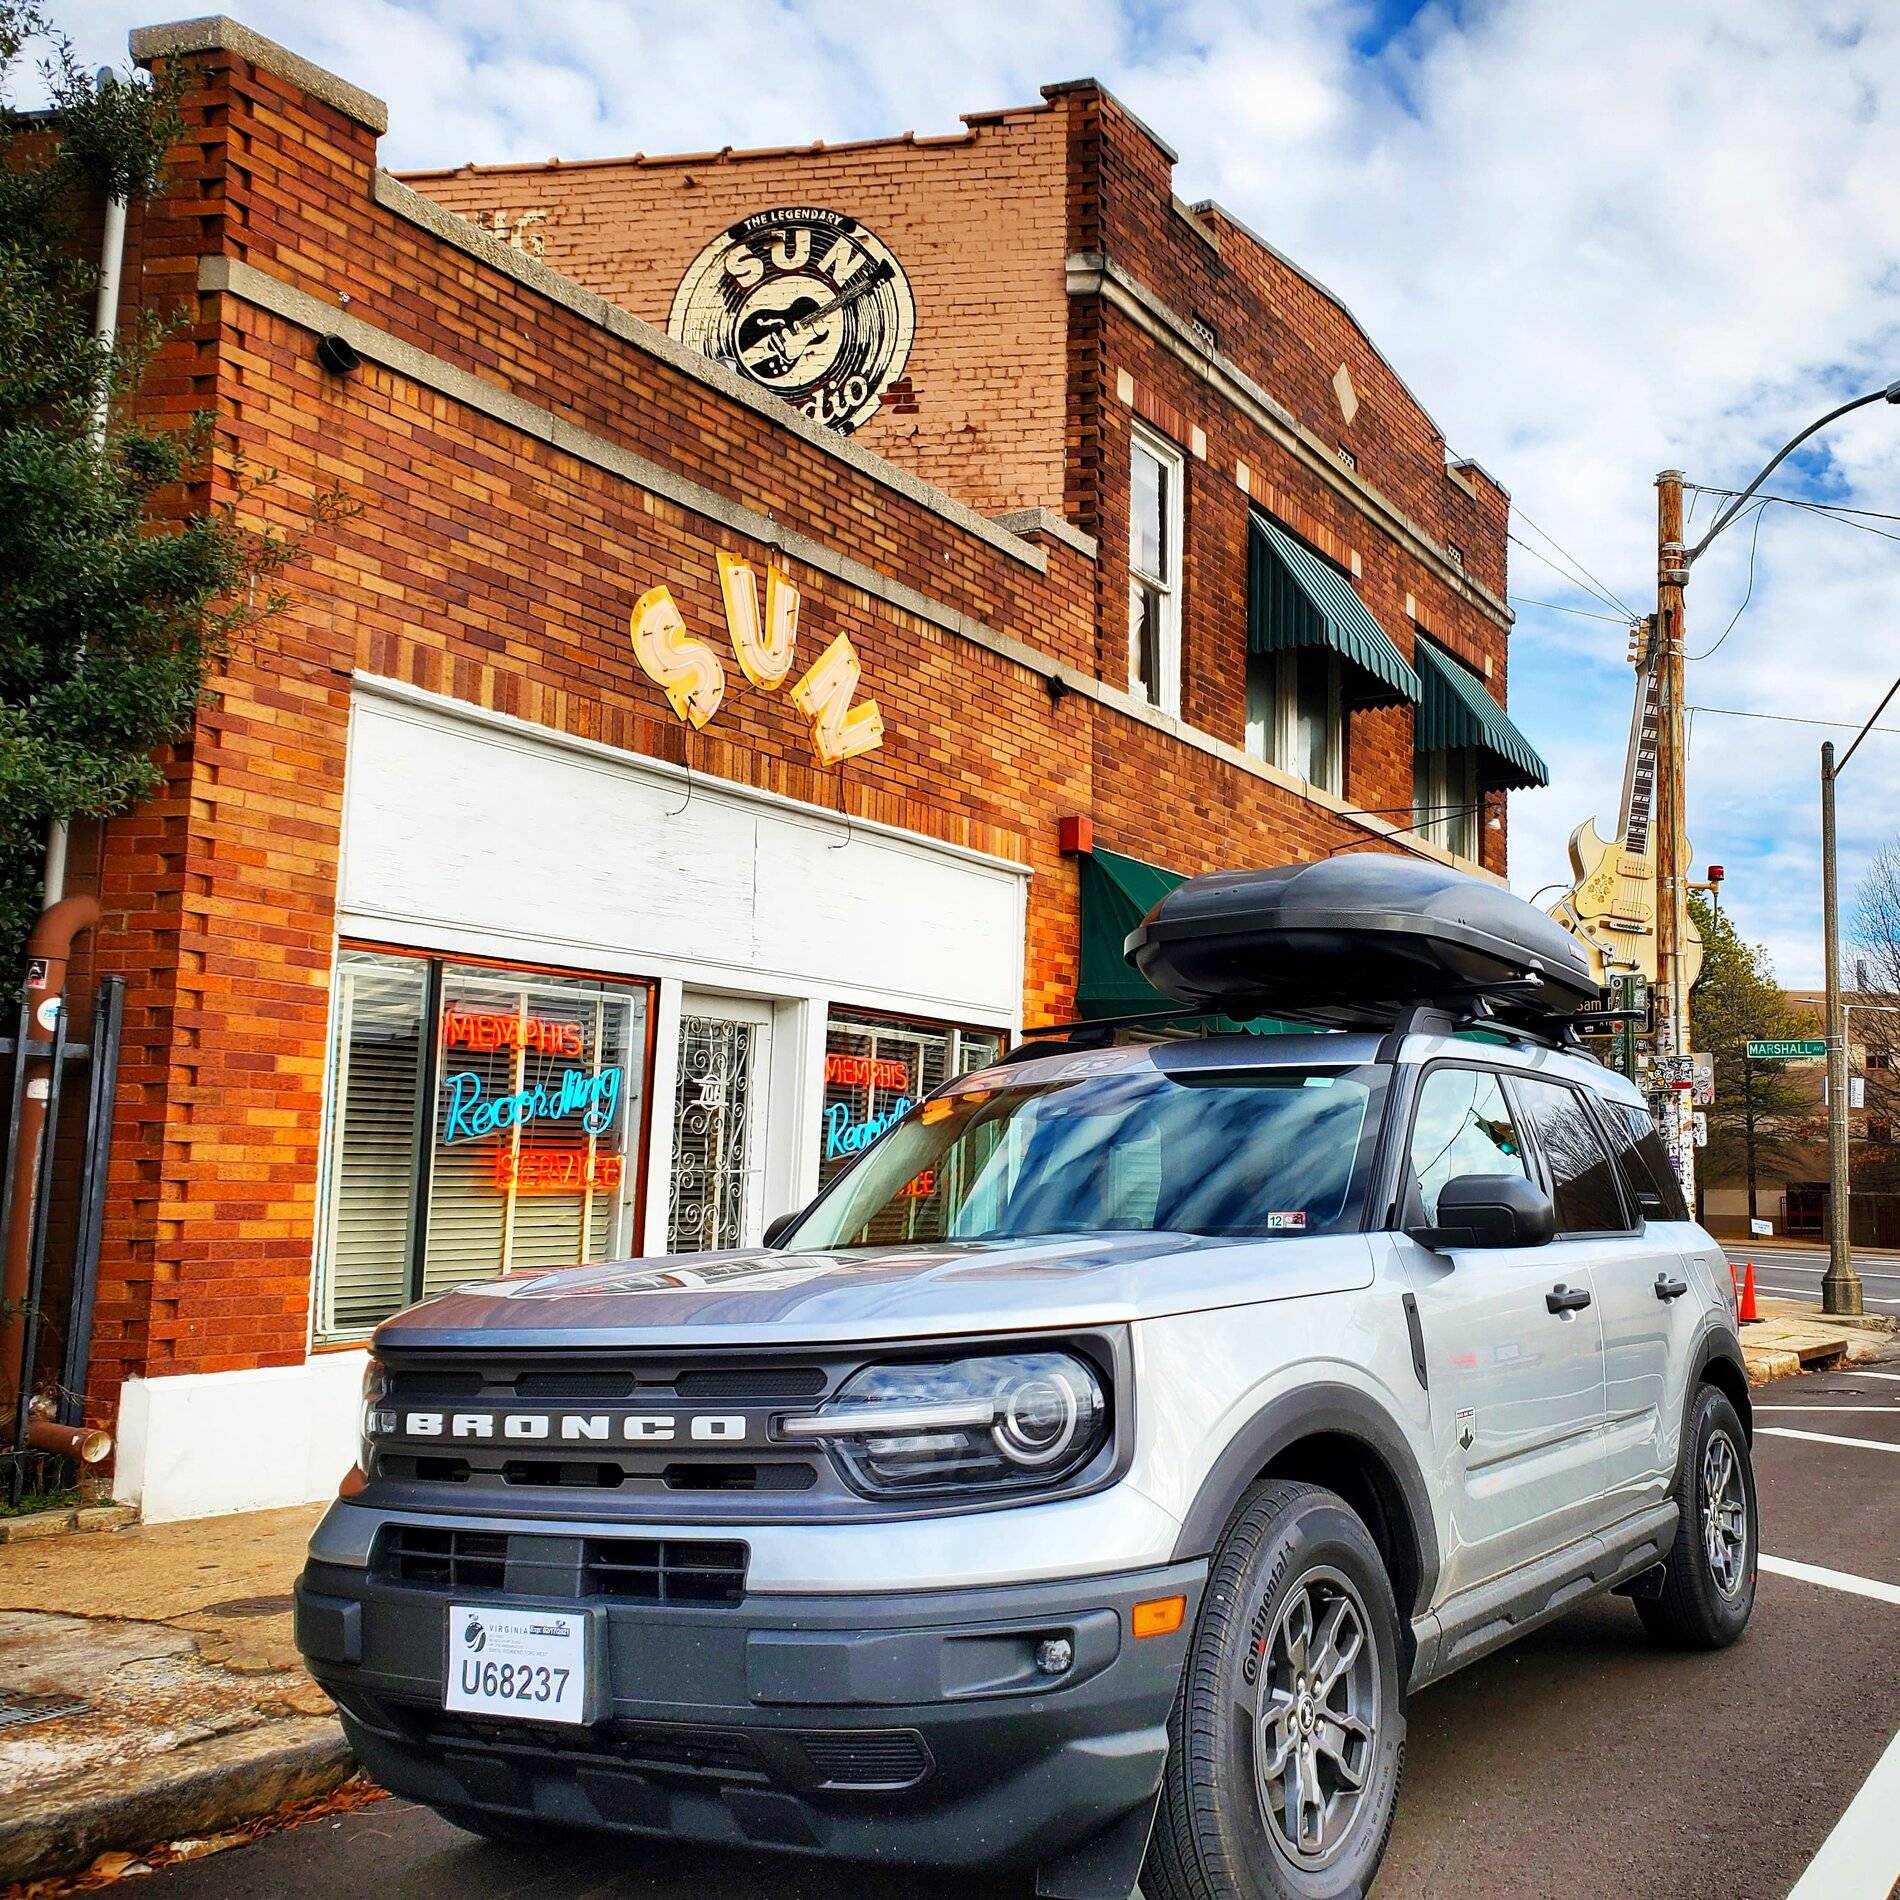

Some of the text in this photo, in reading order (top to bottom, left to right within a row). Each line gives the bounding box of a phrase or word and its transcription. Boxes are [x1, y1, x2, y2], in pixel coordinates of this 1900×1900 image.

[744, 209, 843, 230] THE LEGENDARY
[724, 229, 868, 288] SUN
[800, 375, 868, 422] dio
[630, 552, 885, 767] SUN
[447, 1012, 582, 1057] MEMPHIS
[1749, 1043, 1825, 1055] MARSHALL AVE
[825, 1058, 909, 1090] MEMPHIS
[446, 1066, 623, 1143] Recording
[499, 1154, 622, 1187] SERVICE
[1270, 1215, 1282, 1226] 12
[406, 1412, 746, 1441] BRONCO
[489, 1624, 528, 1635] VIRGINIA
[1242, 1550, 1289, 1686] Continental
[462, 1659, 570, 1703] U68237
